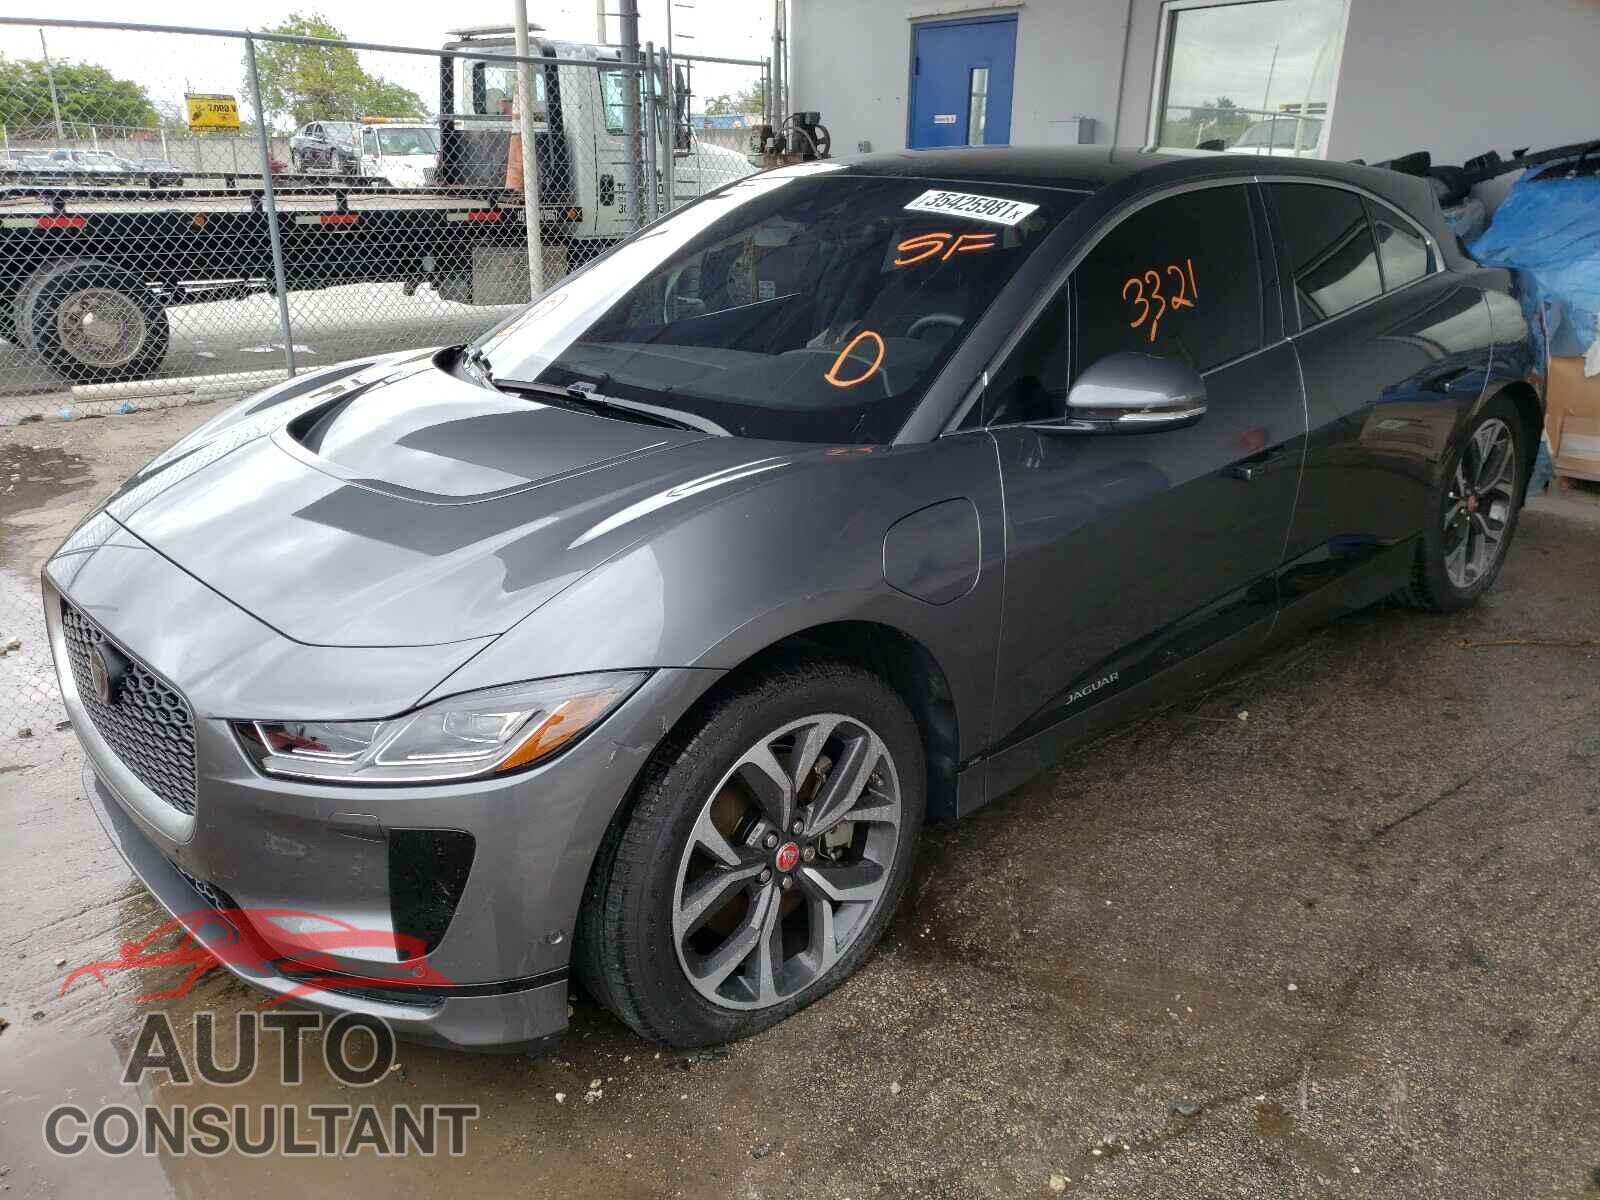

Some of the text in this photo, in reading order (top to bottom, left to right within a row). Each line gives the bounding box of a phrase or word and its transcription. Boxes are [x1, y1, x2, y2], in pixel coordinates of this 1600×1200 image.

[925, 192, 1019, 218] 35425981
[894, 231, 997, 266] SF
[1064, 671, 1120, 705] JAGUAR
